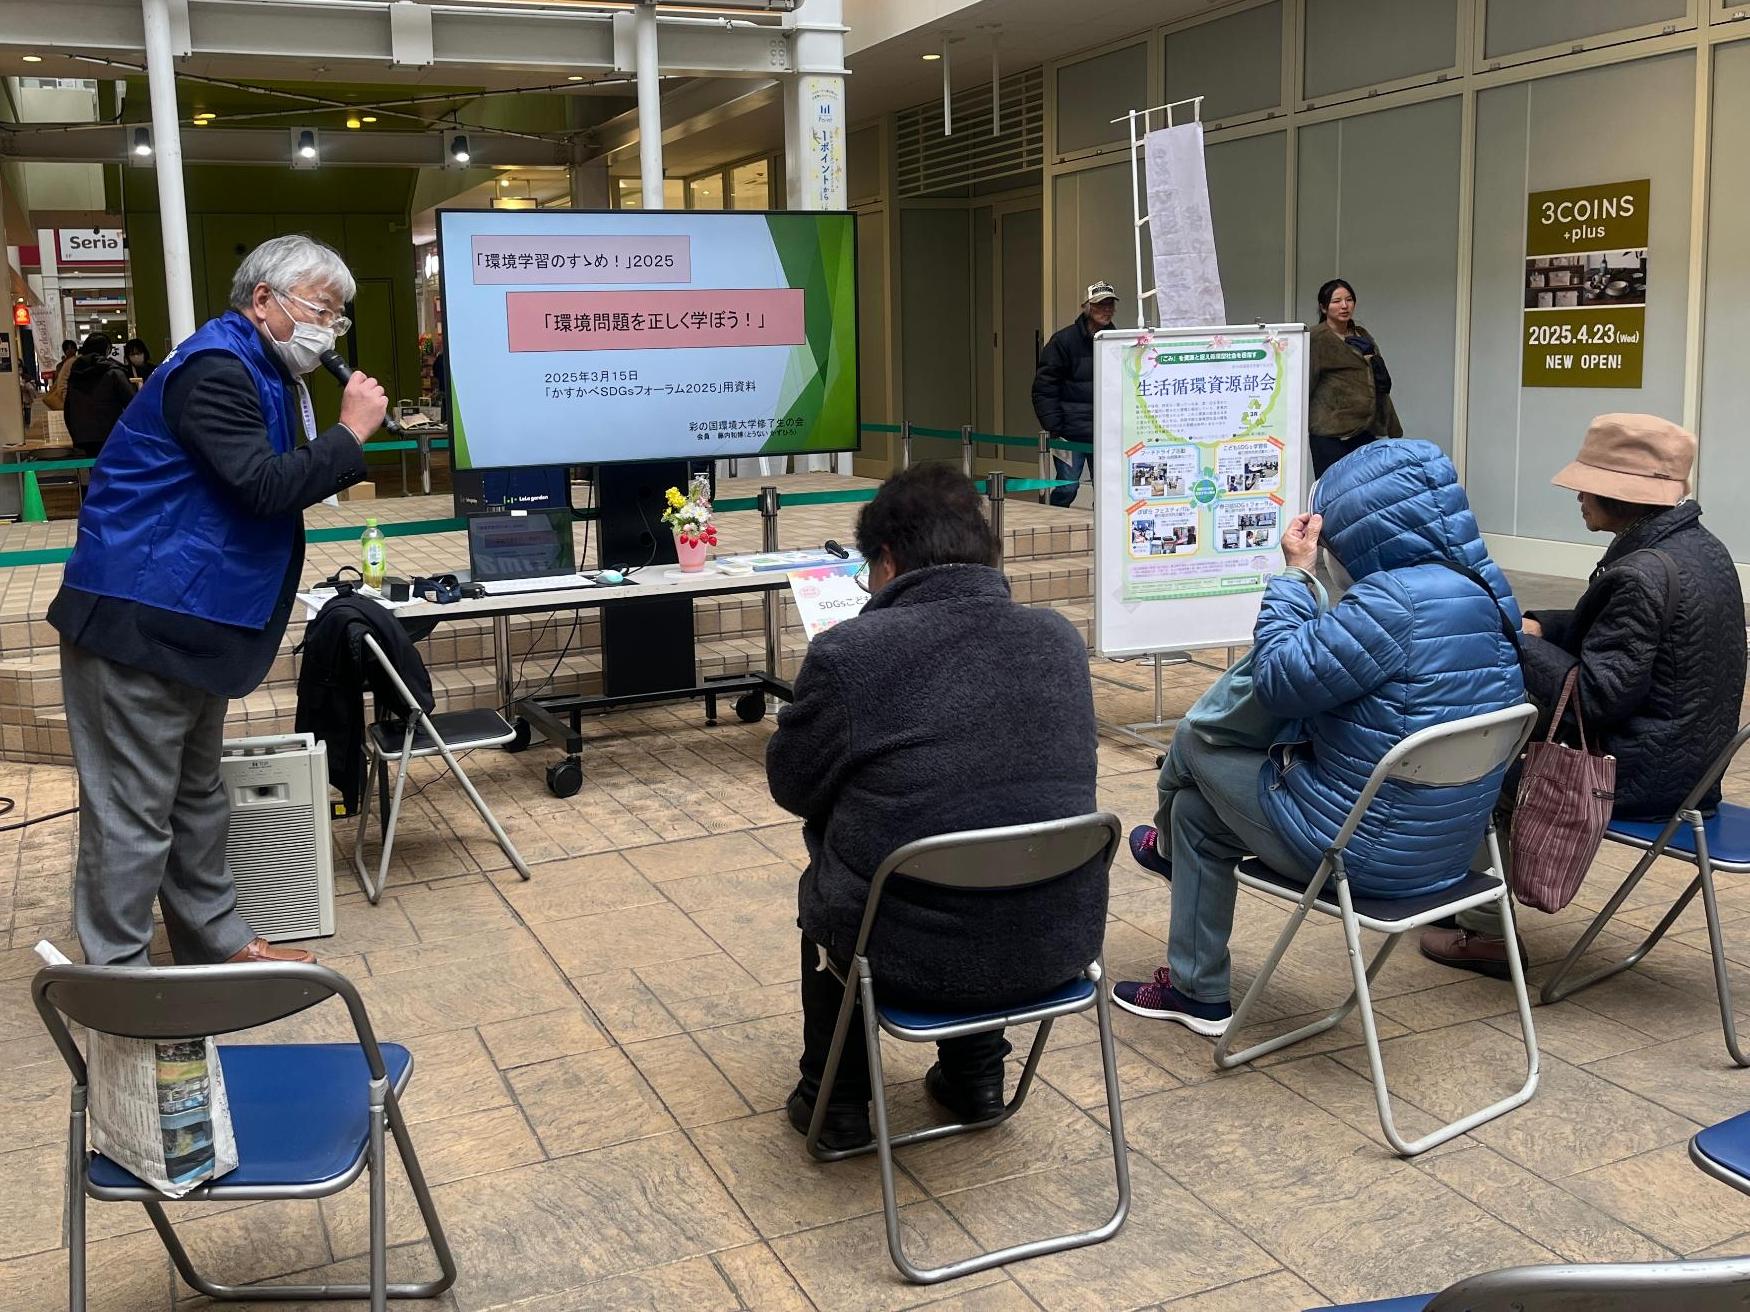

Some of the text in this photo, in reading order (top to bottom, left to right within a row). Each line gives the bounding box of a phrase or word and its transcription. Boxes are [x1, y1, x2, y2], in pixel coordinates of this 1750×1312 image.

[1541, 195, 1635, 225] 3COINS
[69, 235, 118, 250] Seria
[1563, 226, 1606, 243] +plus
[476, 252, 675, 270] 「環境学習のすゝめ！」2025
[544, 310, 766, 333] 「環境問題を正しく学ぼう！」
[1545, 354, 1622, 369] NEW OPEN!
[544, 370, 638, 383] 2025年3月15日
[1136, 372, 1277, 397] 生活循環資源部会
[545, 380, 756, 399] 「かすかべSDGsフォーラム2025」用資料
[688, 417, 805, 432] 彩の国環境大学修了生の会
